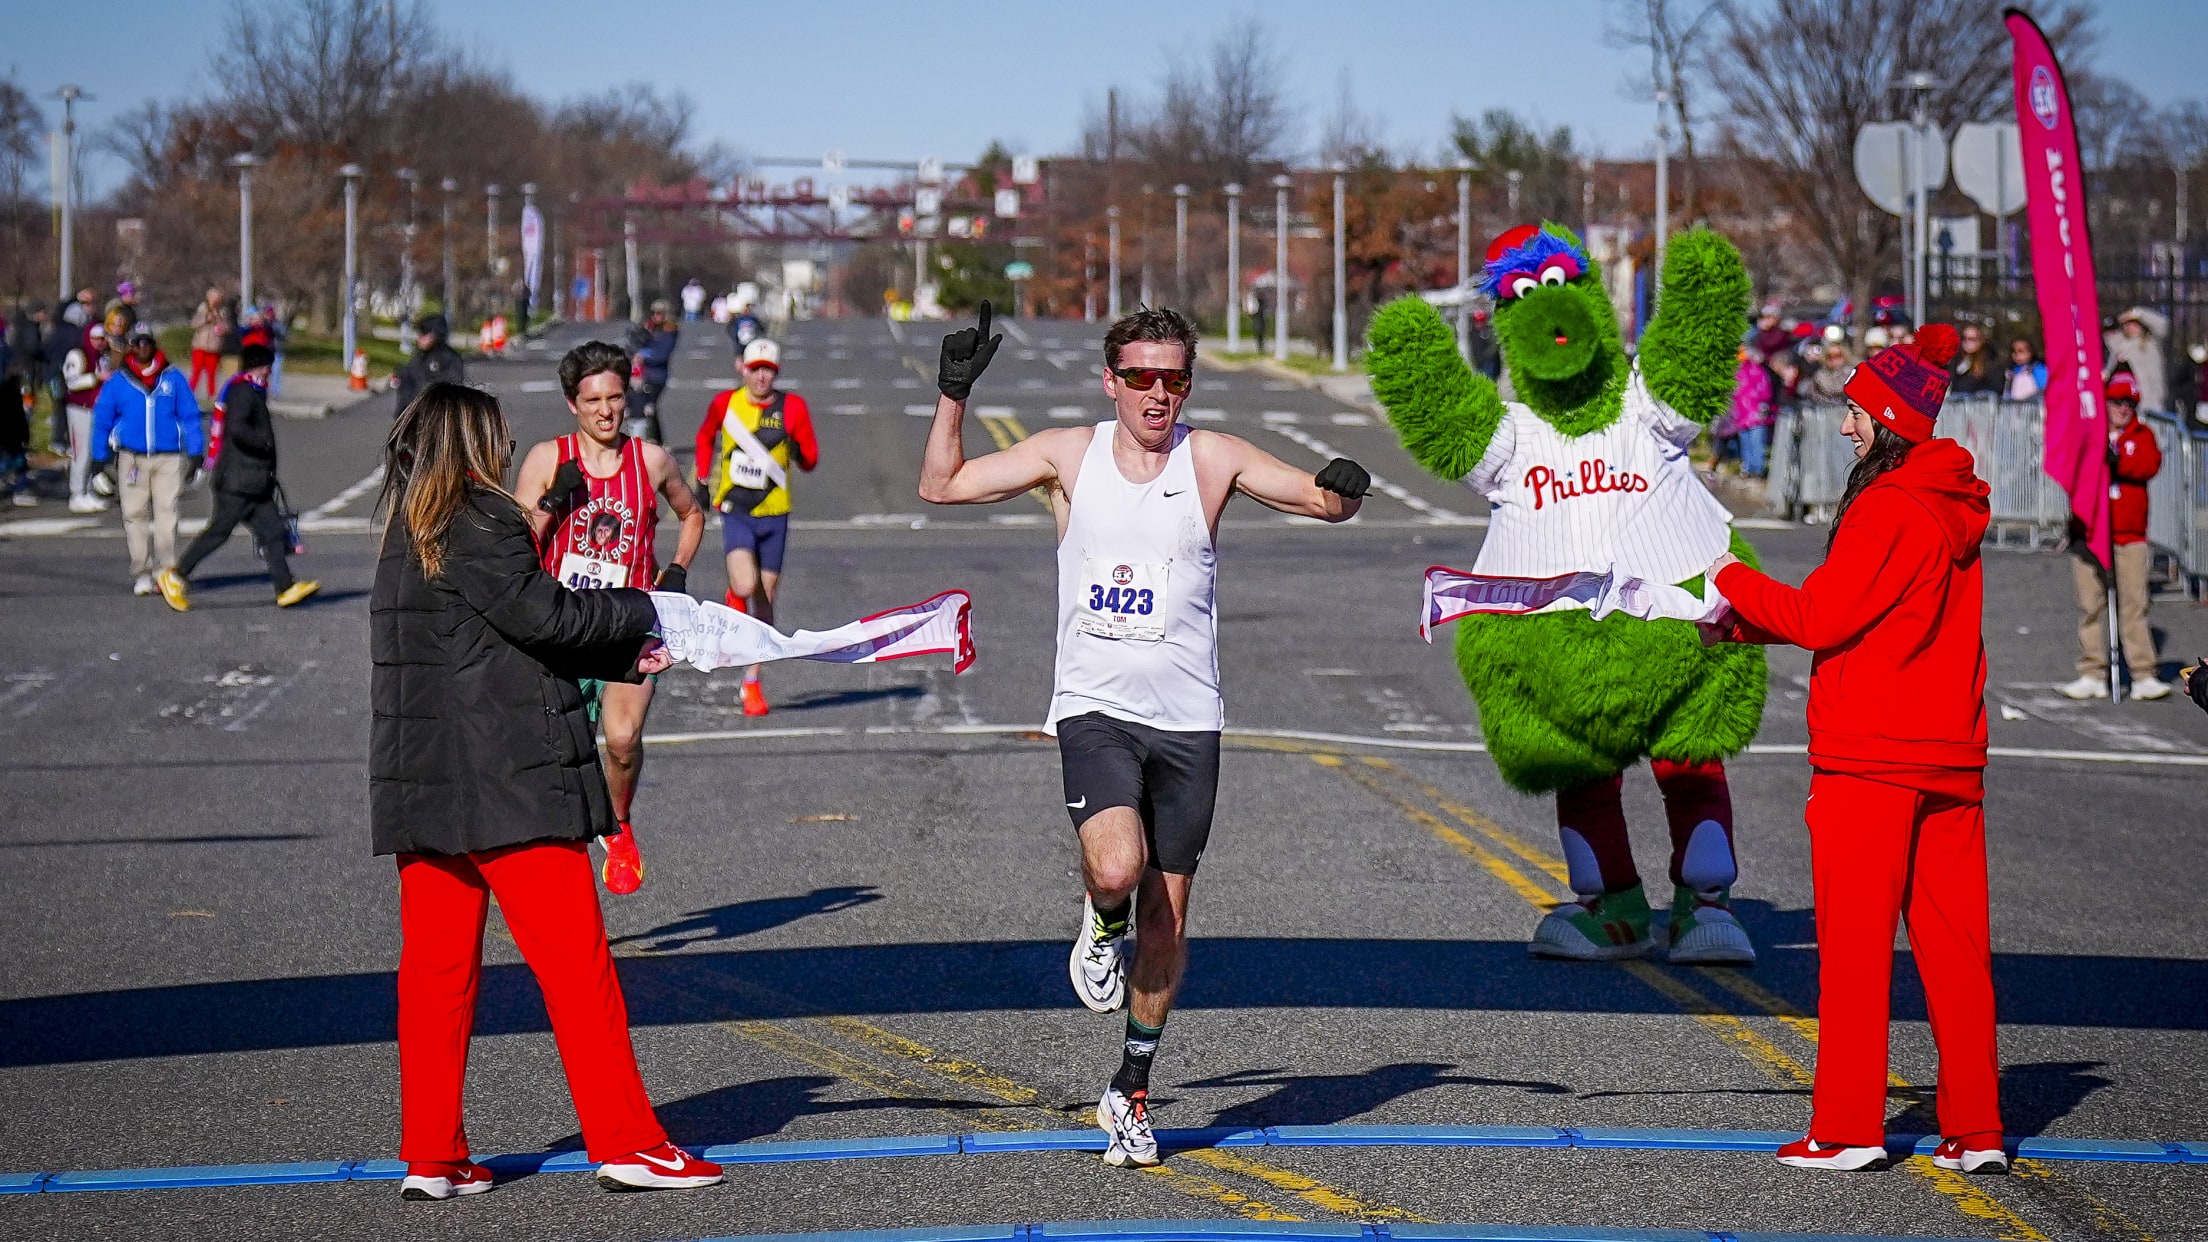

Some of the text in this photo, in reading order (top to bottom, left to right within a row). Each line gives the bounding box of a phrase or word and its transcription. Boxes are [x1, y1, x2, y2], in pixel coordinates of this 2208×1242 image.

[1524, 458, 1649, 510] Phillies
[1089, 584, 1154, 615] 3423
[1113, 616, 1127, 624] TOM
